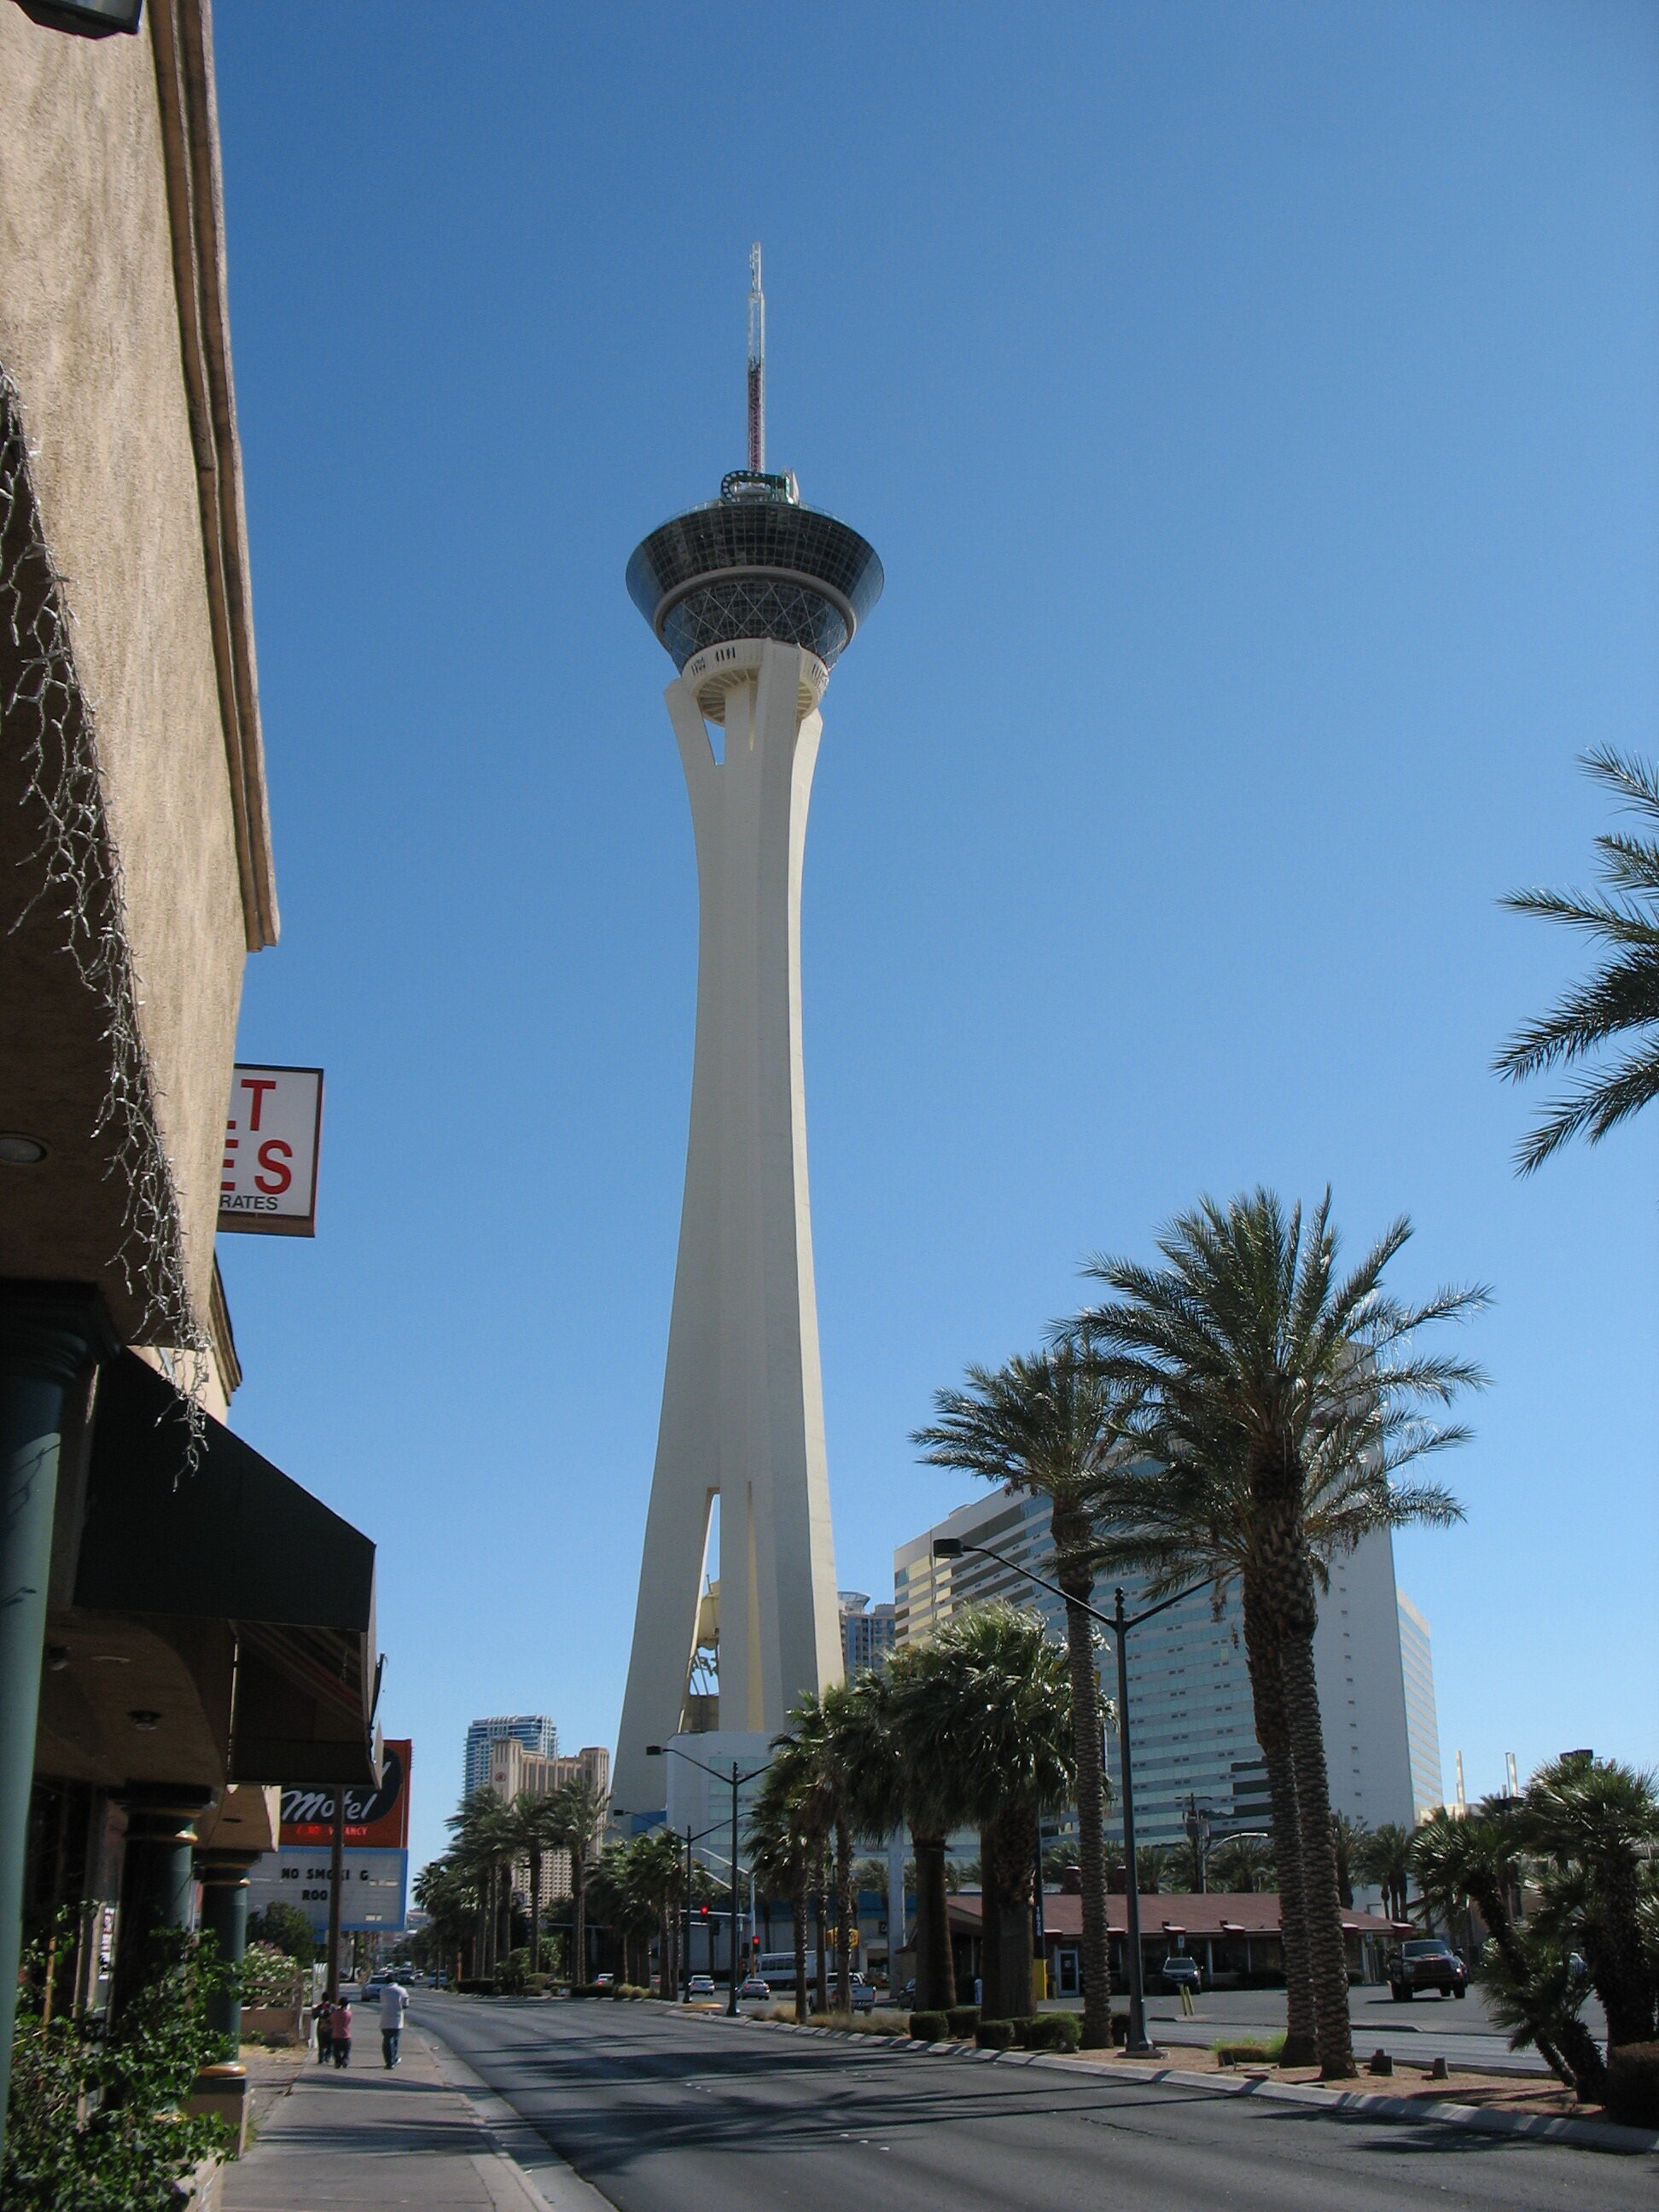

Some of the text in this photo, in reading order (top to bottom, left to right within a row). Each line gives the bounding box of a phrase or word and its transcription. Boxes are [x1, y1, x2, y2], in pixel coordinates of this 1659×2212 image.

[219, 1195, 278, 1210] RATES
[328, 1825, 369, 1836] VANCY
[282, 1868, 299, 1879] NO
